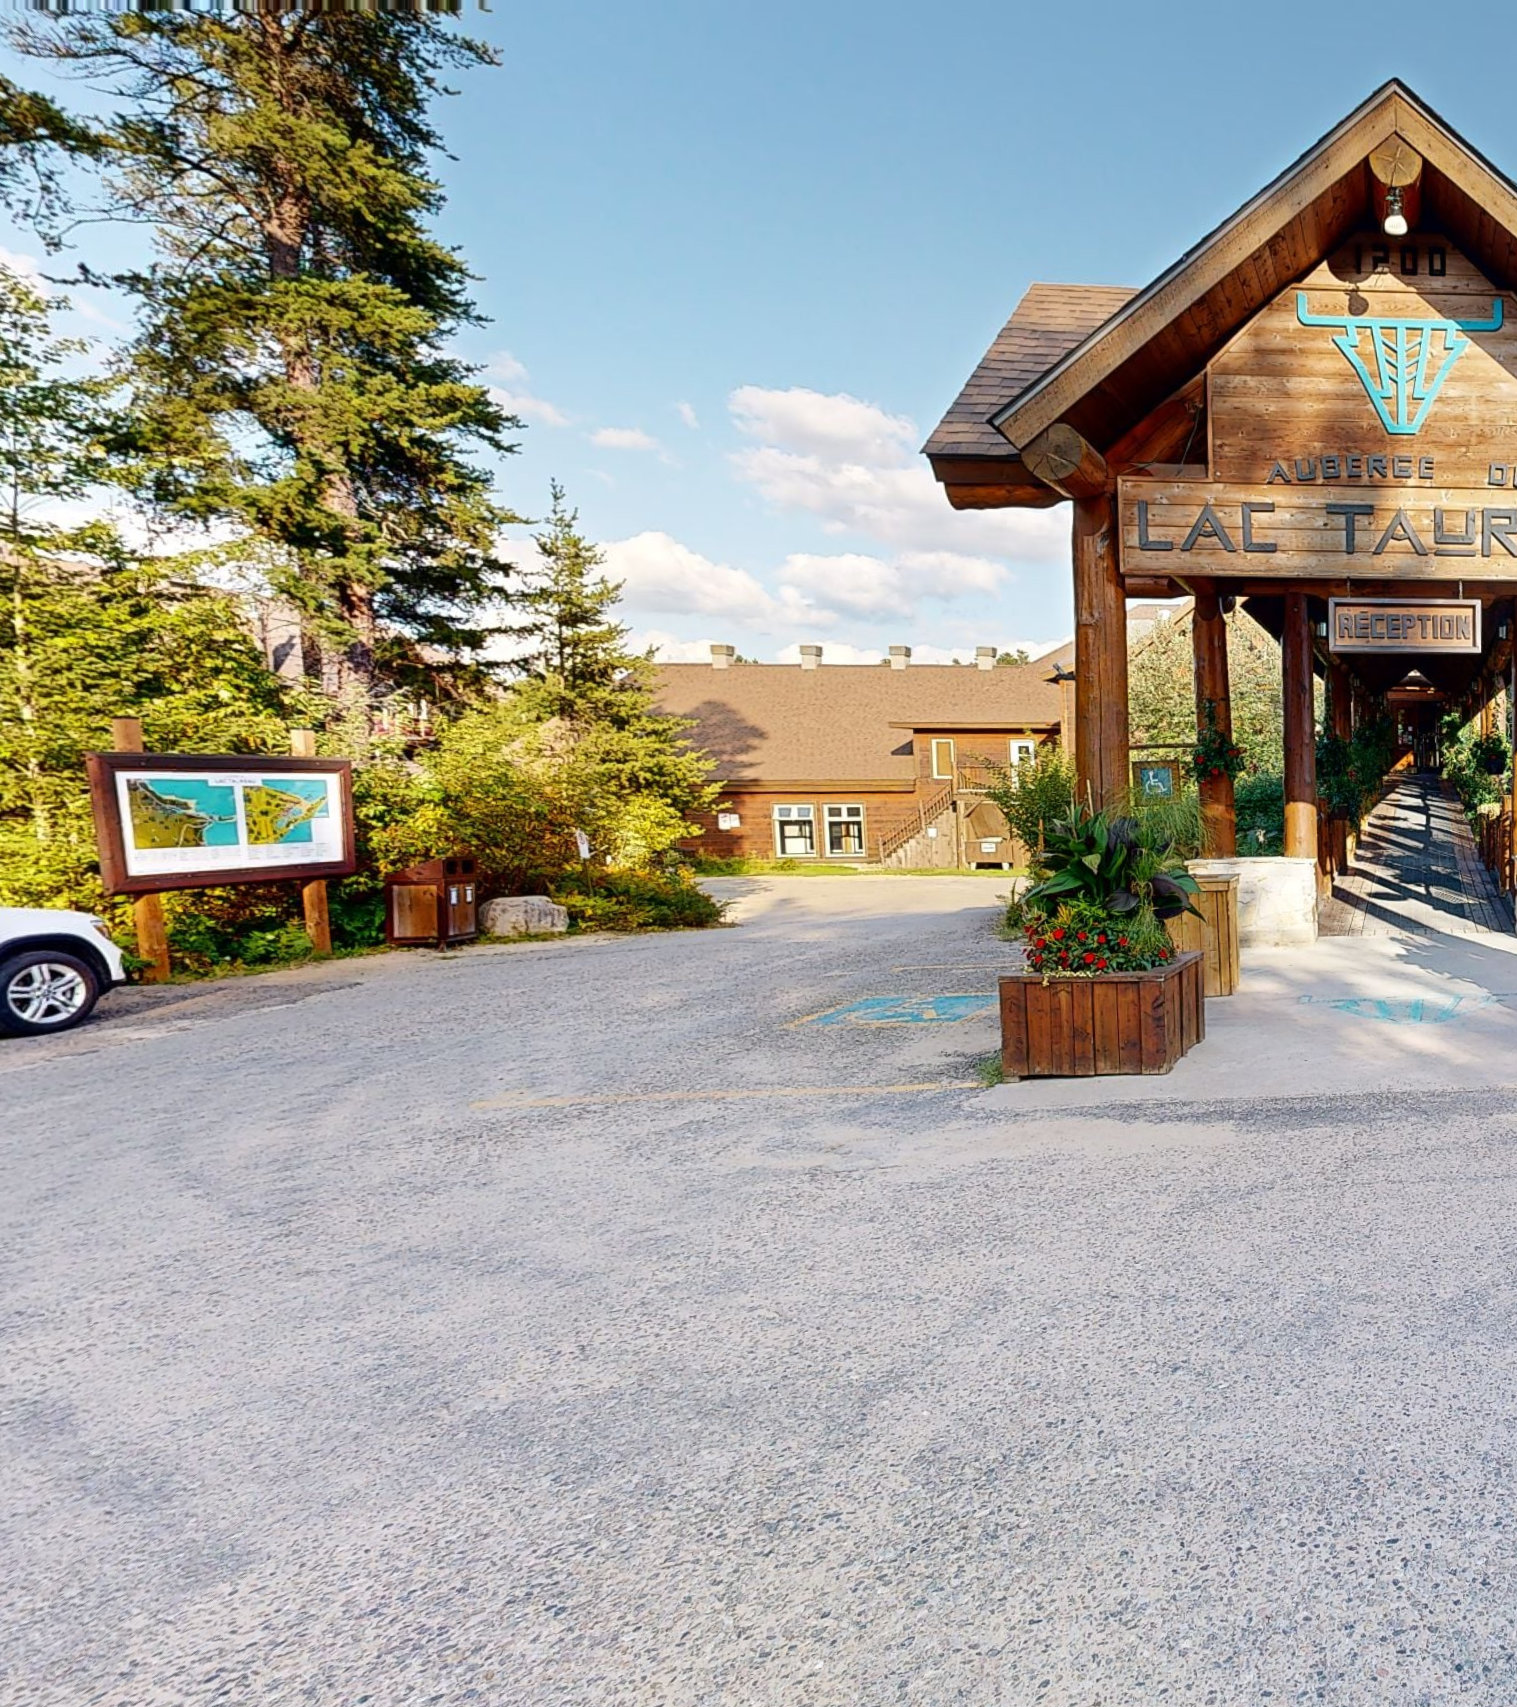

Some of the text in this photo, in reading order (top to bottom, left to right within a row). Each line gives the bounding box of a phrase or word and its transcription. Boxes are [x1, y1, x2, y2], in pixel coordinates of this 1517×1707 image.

[1354, 243, 1446, 276] 1200
[1266, 454, 1435, 484] AUBERGE
[1137, 500, 1278, 553] LAC
[1338, 611, 1471, 640] RÉCEPTION
